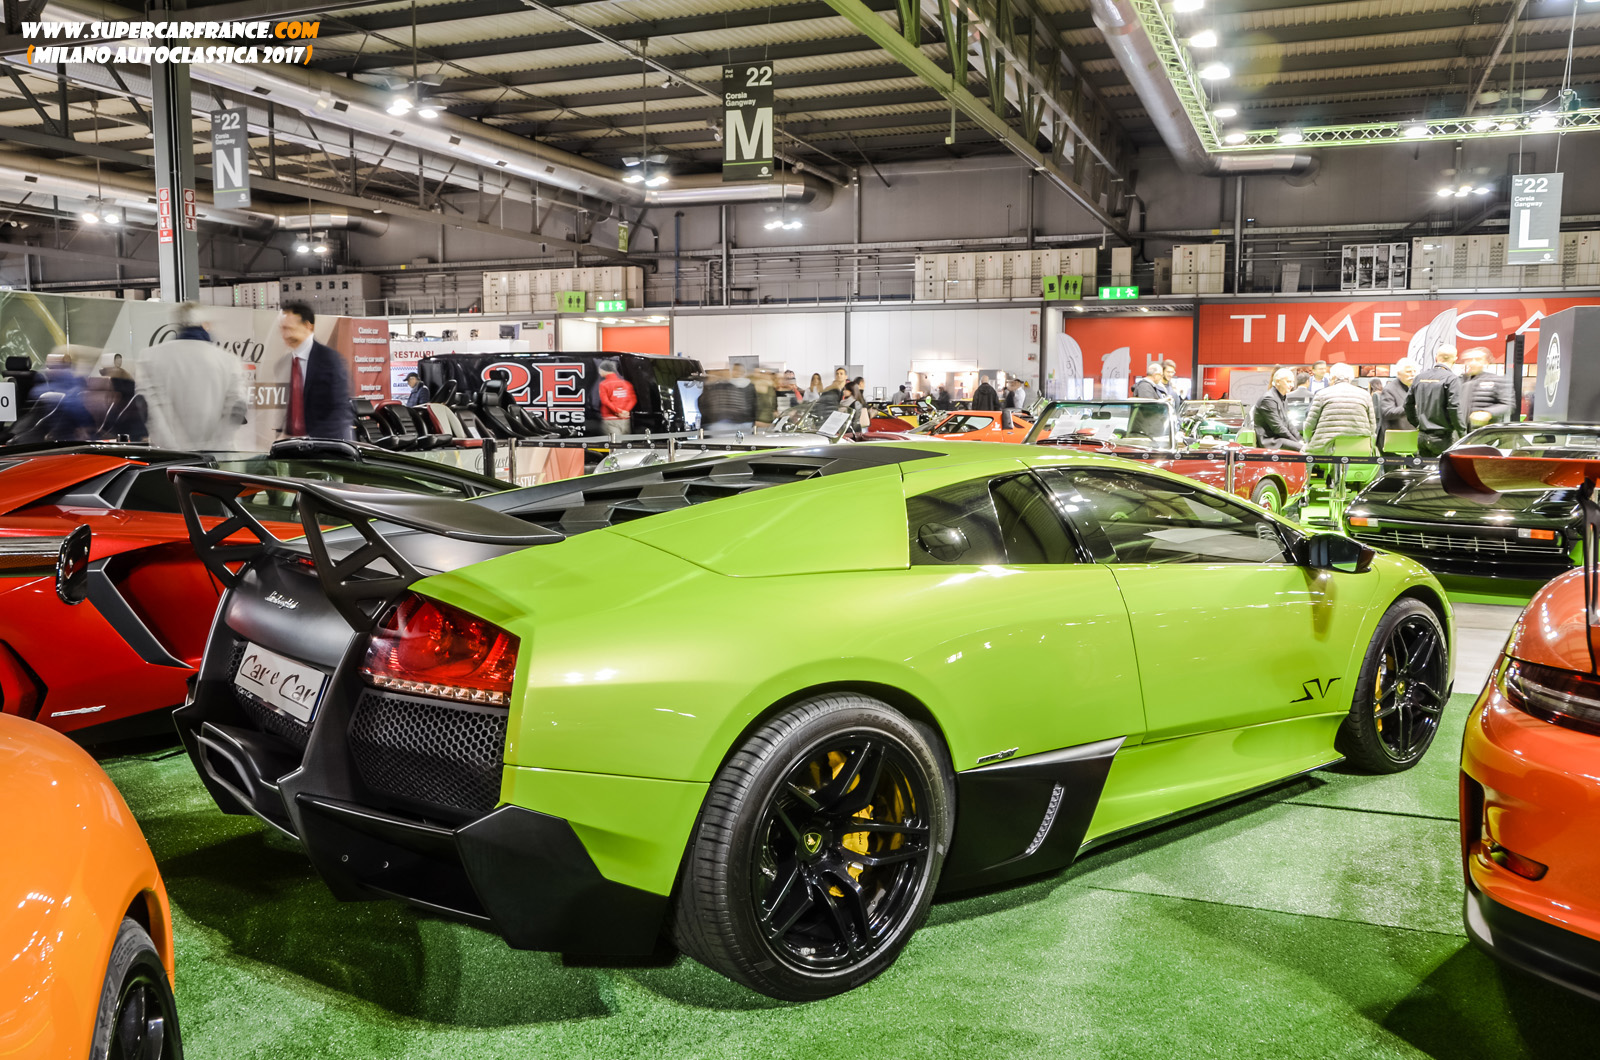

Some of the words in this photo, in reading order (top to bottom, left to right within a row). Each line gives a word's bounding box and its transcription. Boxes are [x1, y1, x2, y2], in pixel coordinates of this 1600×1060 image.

[746, 65, 773, 87] 22
[725, 92, 748, 100] Corsia
[725, 98, 756, 107] Gangway
[221, 112, 241, 131] 22
[725, 106, 773, 161] M
[215, 147, 243, 189] N
[1523, 177, 1549, 194] 22
[1518, 208, 1550, 249] L
[1229, 311, 1402, 344] TIME
[1455, 309, 1546, 341] CA
[481, 362, 586, 405] 2E
[240, 654, 271, 686] Car
[269, 671, 280, 685] e
[279, 674, 316, 710] Car
[1289, 677, 1342, 703] SV
